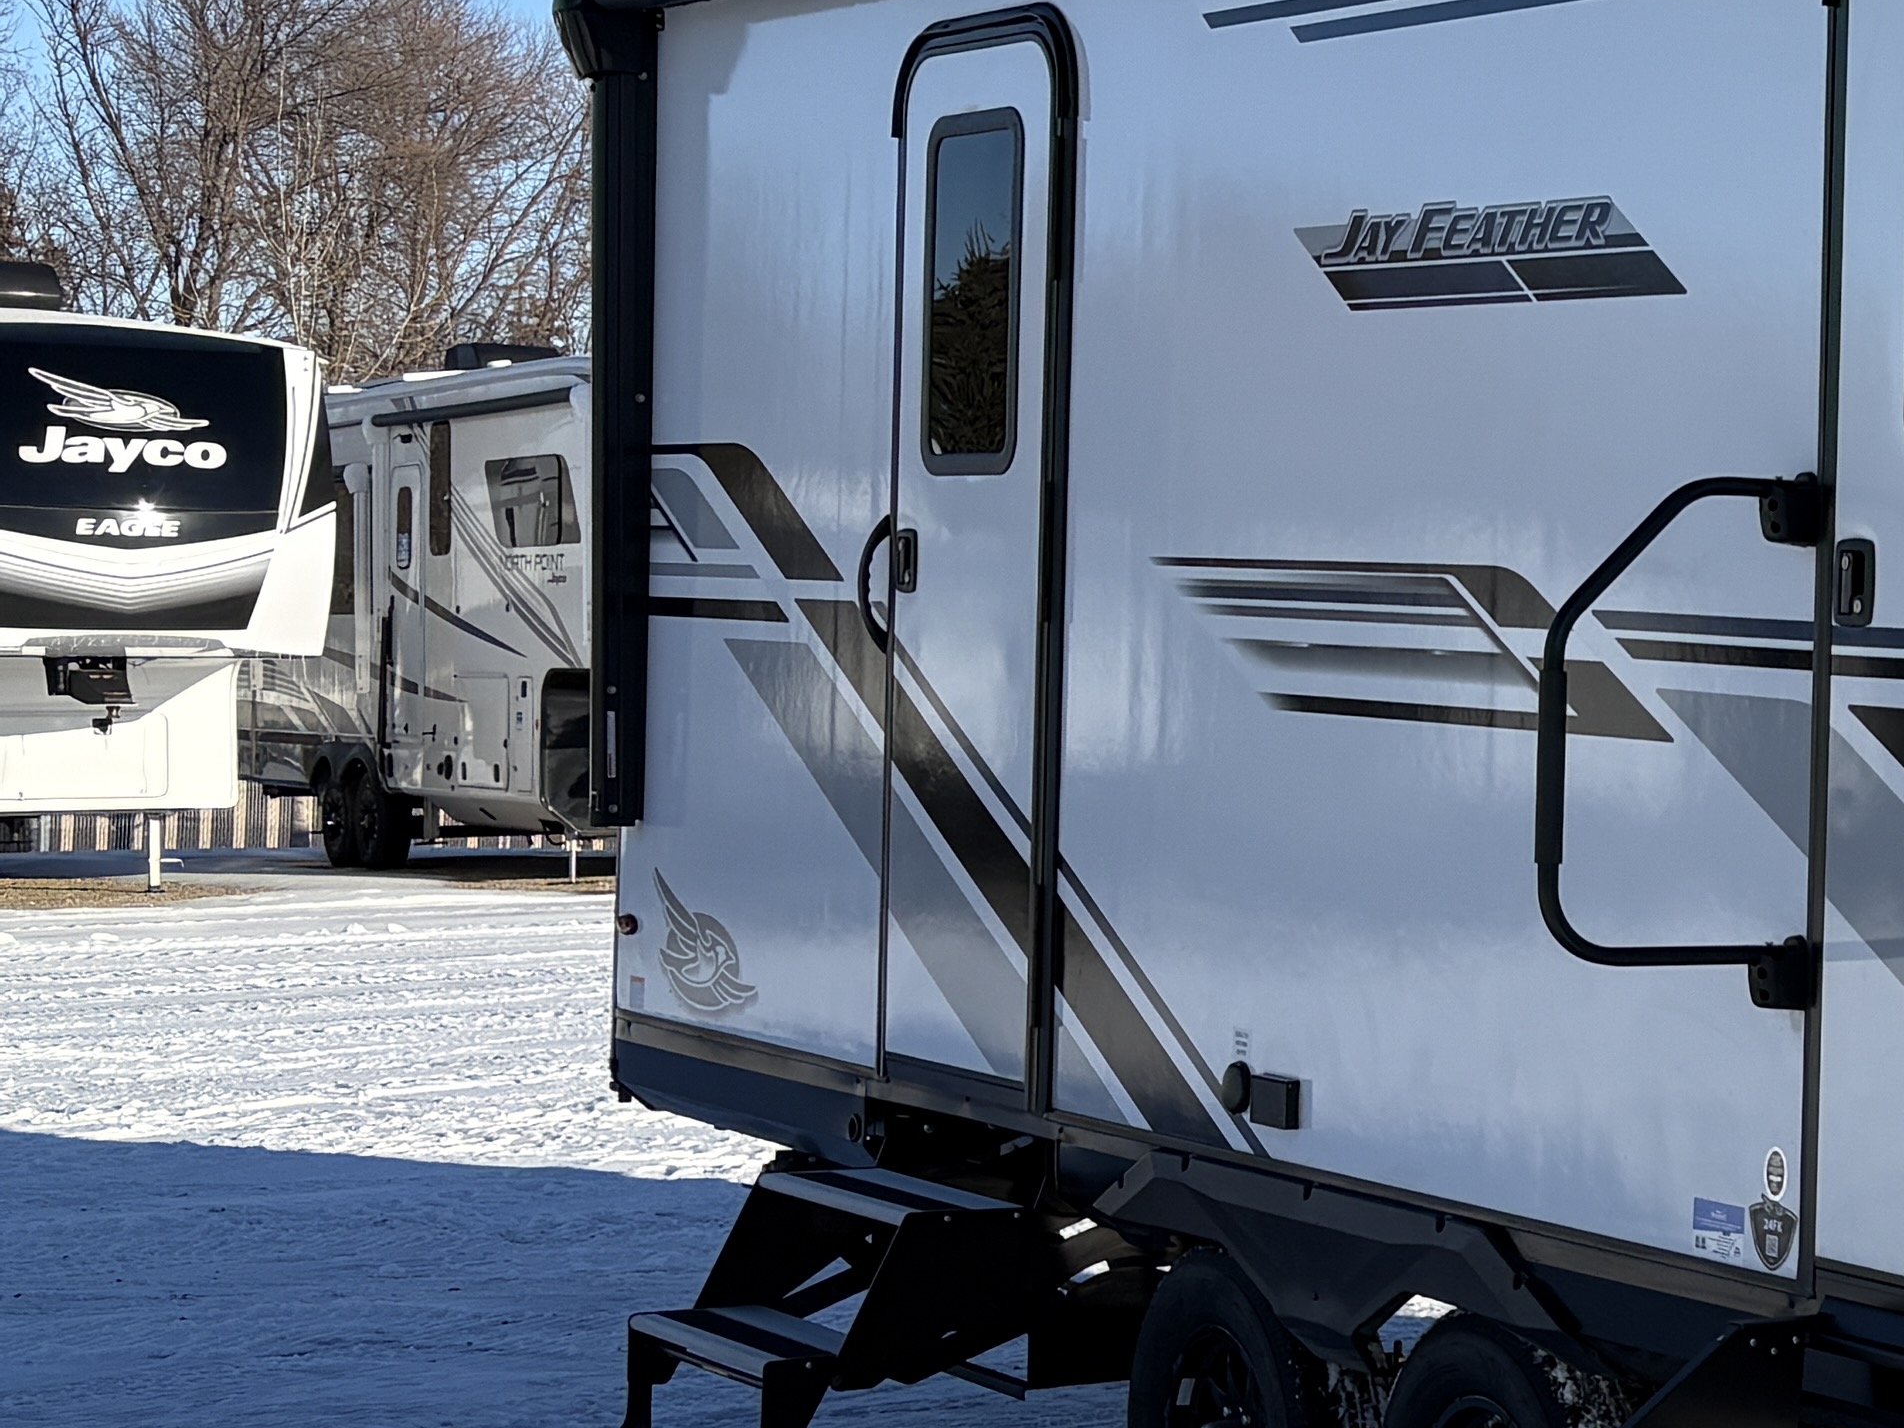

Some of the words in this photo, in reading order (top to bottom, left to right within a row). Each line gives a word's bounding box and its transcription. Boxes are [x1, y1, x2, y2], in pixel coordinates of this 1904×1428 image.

[1321, 209, 1411, 265] JAY
[1407, 200, 1613, 259] FEATHER
[18, 425, 228, 473] Jayco
